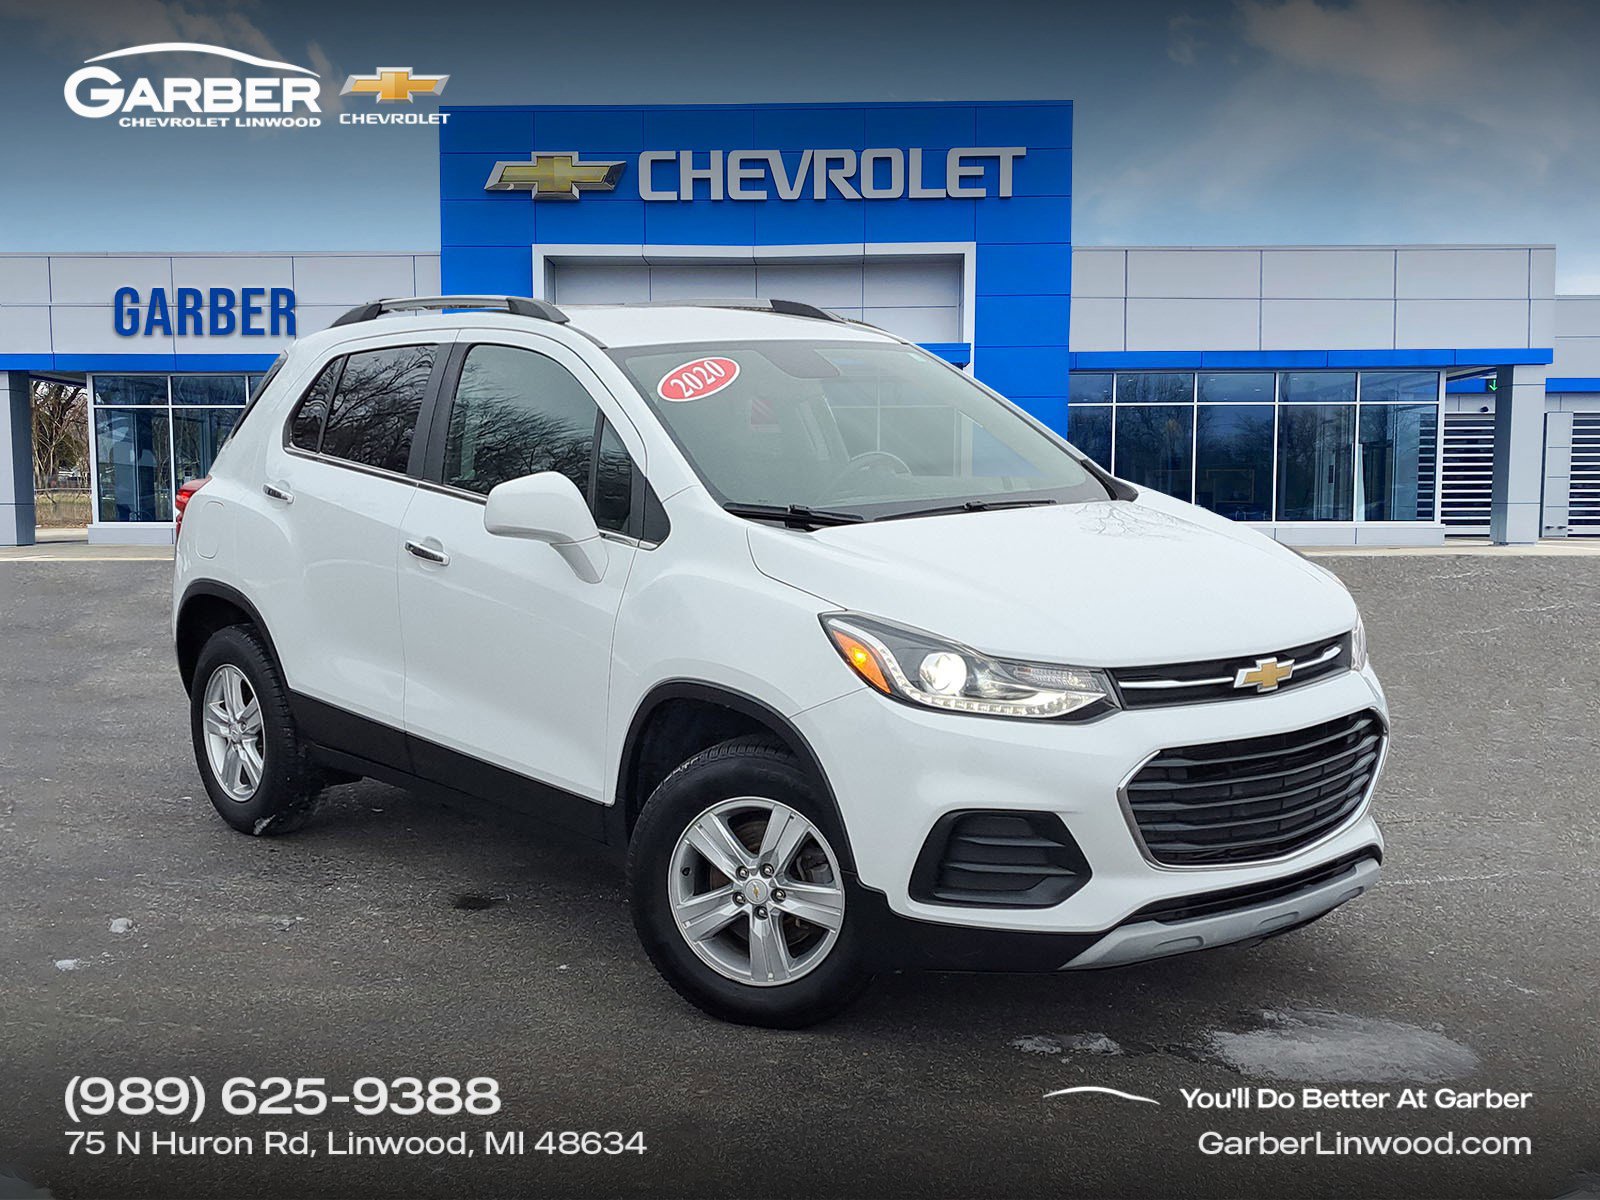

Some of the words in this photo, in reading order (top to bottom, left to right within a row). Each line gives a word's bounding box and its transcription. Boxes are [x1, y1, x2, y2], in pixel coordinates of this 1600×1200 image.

[638, 146, 1027, 201] CHEVROLET
[113, 286, 297, 337] GARBER
[669, 359, 726, 399] 2020
